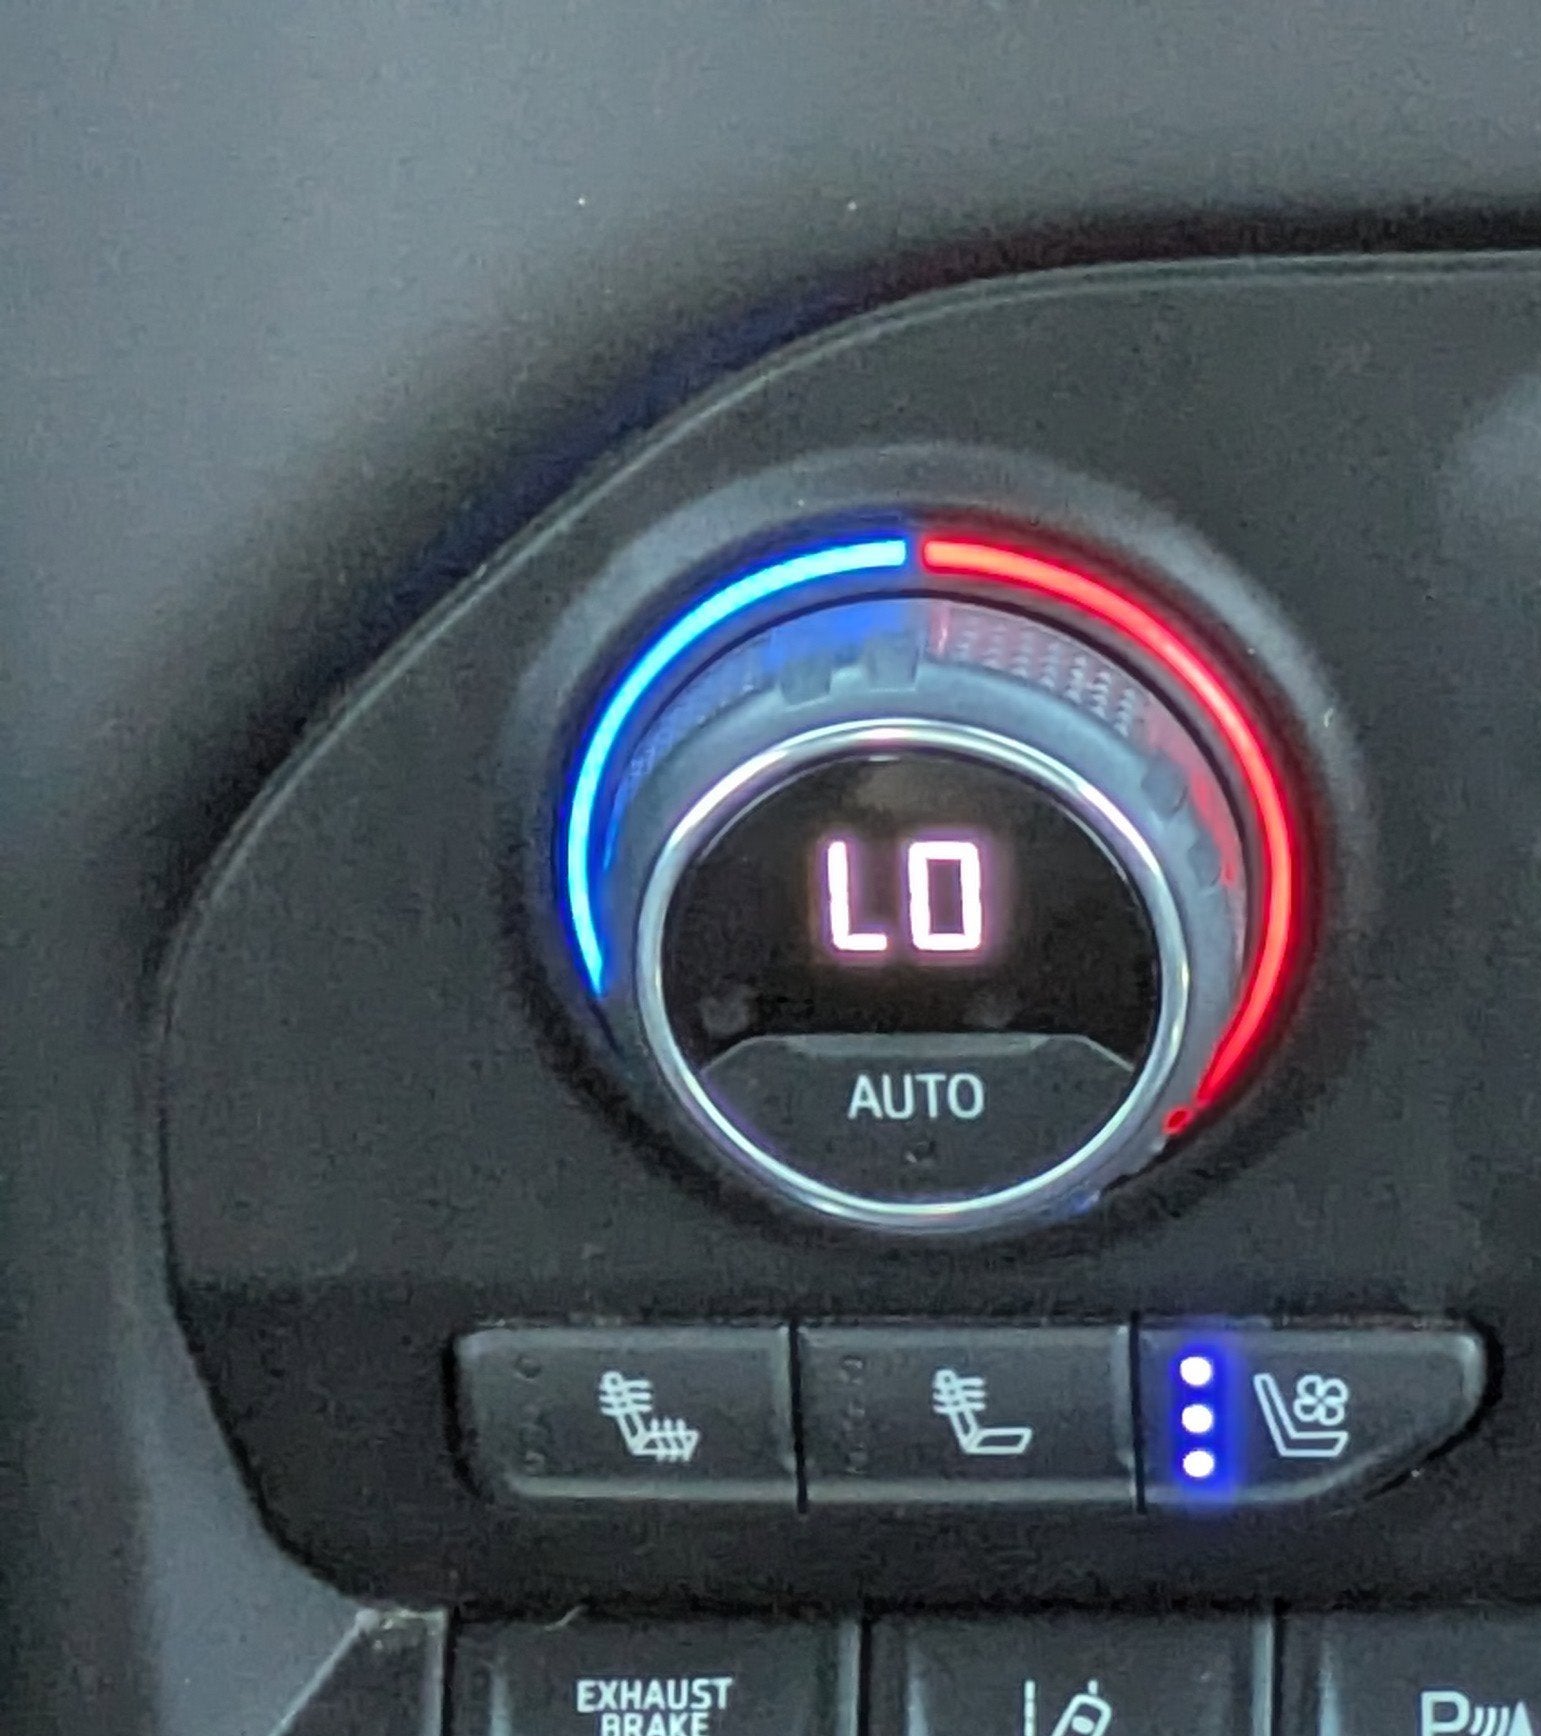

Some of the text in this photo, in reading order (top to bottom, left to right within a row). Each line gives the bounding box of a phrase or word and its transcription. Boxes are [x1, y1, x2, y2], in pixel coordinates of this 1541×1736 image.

[825, 838, 985, 952] LO
[848, 1073, 984, 1119] AUTO
[577, 1677, 733, 1712] EXHAUST
